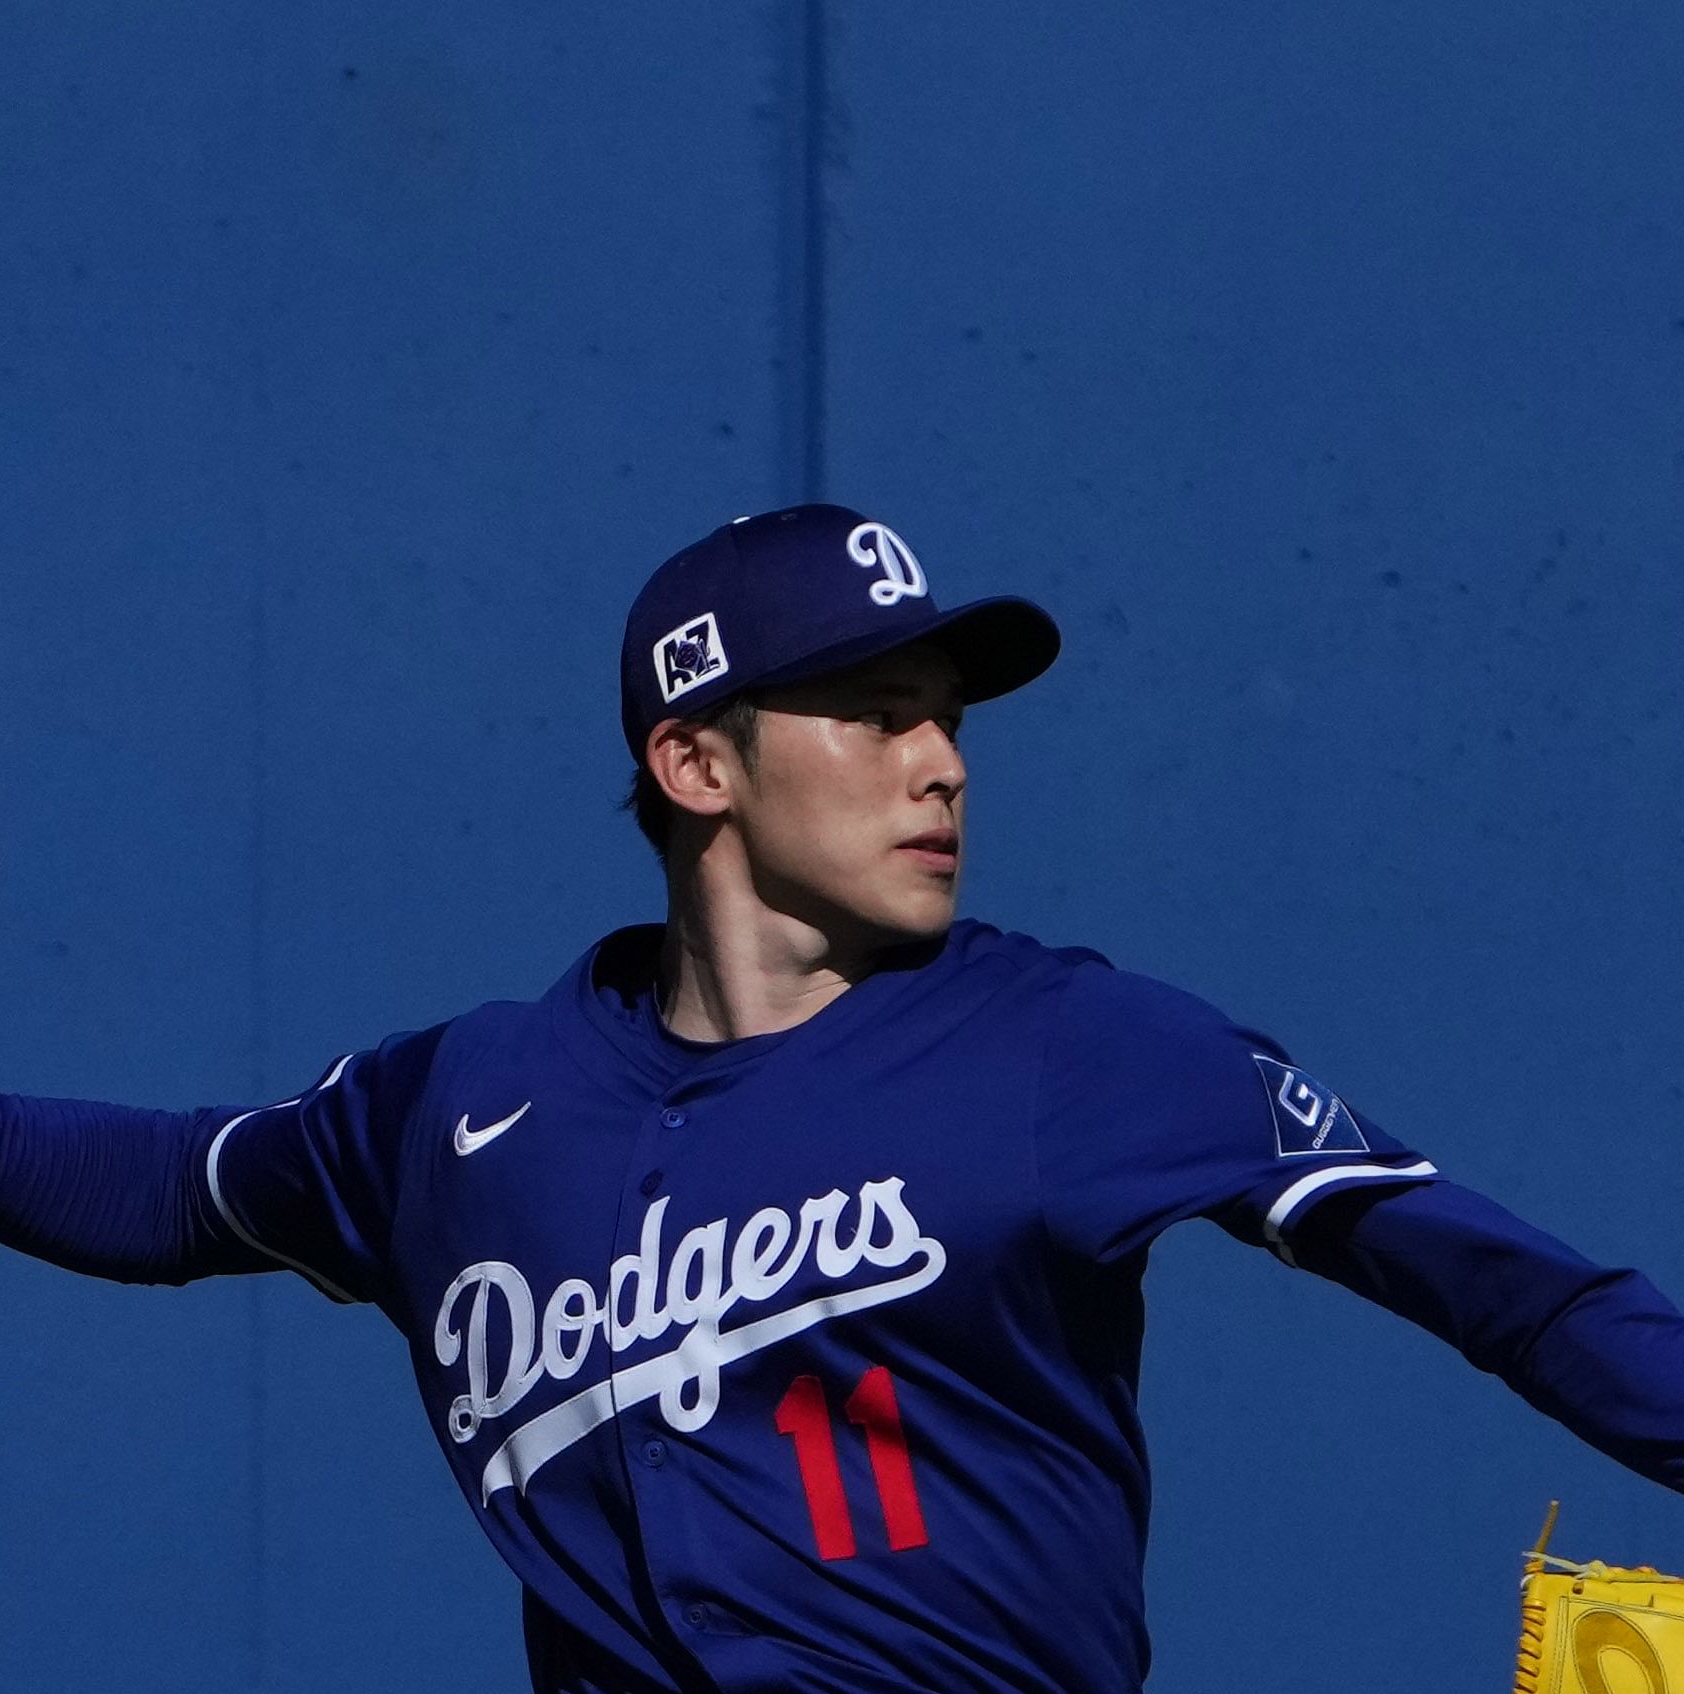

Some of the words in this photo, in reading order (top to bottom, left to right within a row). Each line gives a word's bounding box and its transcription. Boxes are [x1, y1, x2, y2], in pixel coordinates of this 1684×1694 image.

[846, 521, 928, 606] D
[1312, 1098, 1340, 1150] GUGGENHE
[434, 1176, 946, 1508] Dodgers
[775, 1366, 929, 1562] 11
